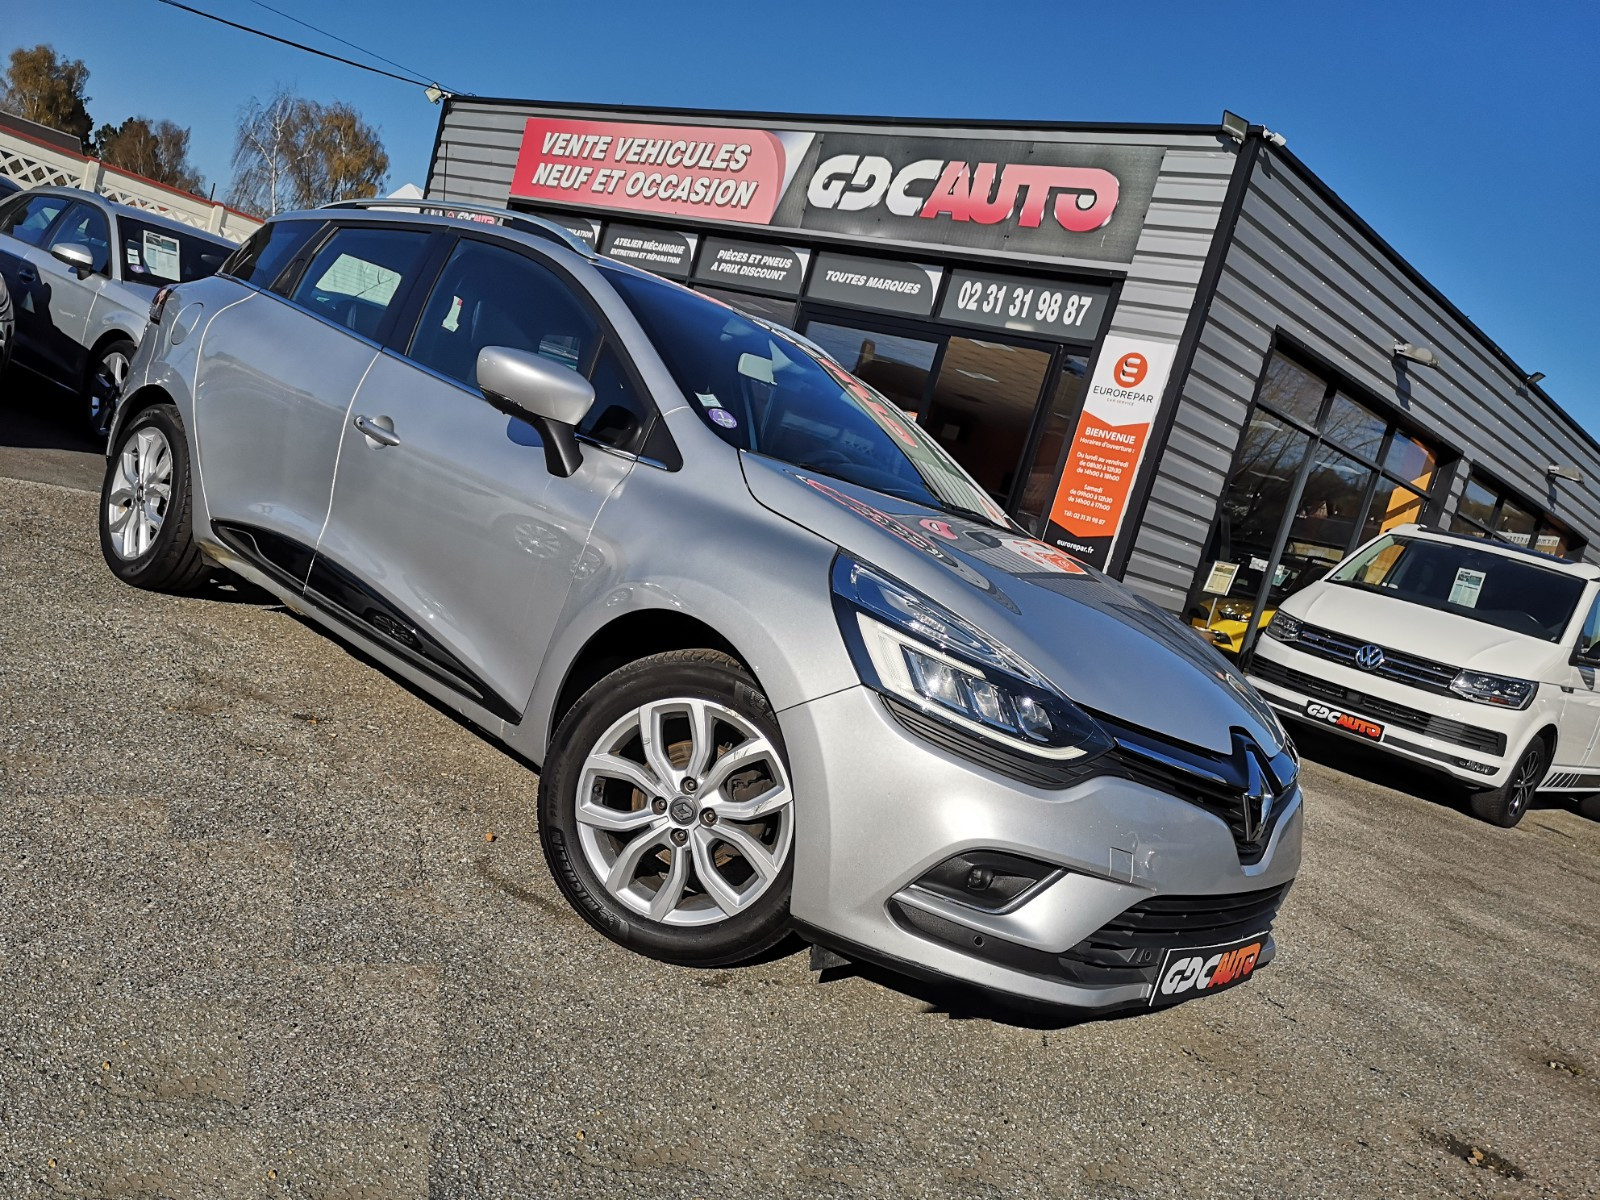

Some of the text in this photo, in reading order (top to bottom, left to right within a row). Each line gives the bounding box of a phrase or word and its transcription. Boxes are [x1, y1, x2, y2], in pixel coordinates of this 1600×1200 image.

[540, 132, 752, 170] VENTE VEHICULES
[531, 162, 757, 208] NEUF ET OCCASION
[613, 237, 686, 254] ATELIER MÉCANIQUE
[610, 247, 681, 264] ENTRETIEN ET RÉPARATION
[717, 248, 793, 268] PIÈCES ET PNEUS
[710, 261, 786, 280] A PRIX DISCOUNT
[825, 270, 922, 295] TOUTES MARQUES
[957, 280, 1093, 326] 02 31 31 98 87
[1093, 385, 1154, 403] EUROREPAR
[1079, 436, 1102, 447] Horaires
[1085, 426, 1136, 445] BIENVENUE
[1084, 453, 1099, 461] lundi
[1105, 458, 1129, 468] vendredi
[1083, 484, 1103, 493] Samedi
[1056, 539, 1095, 554] eurorepar.fr
